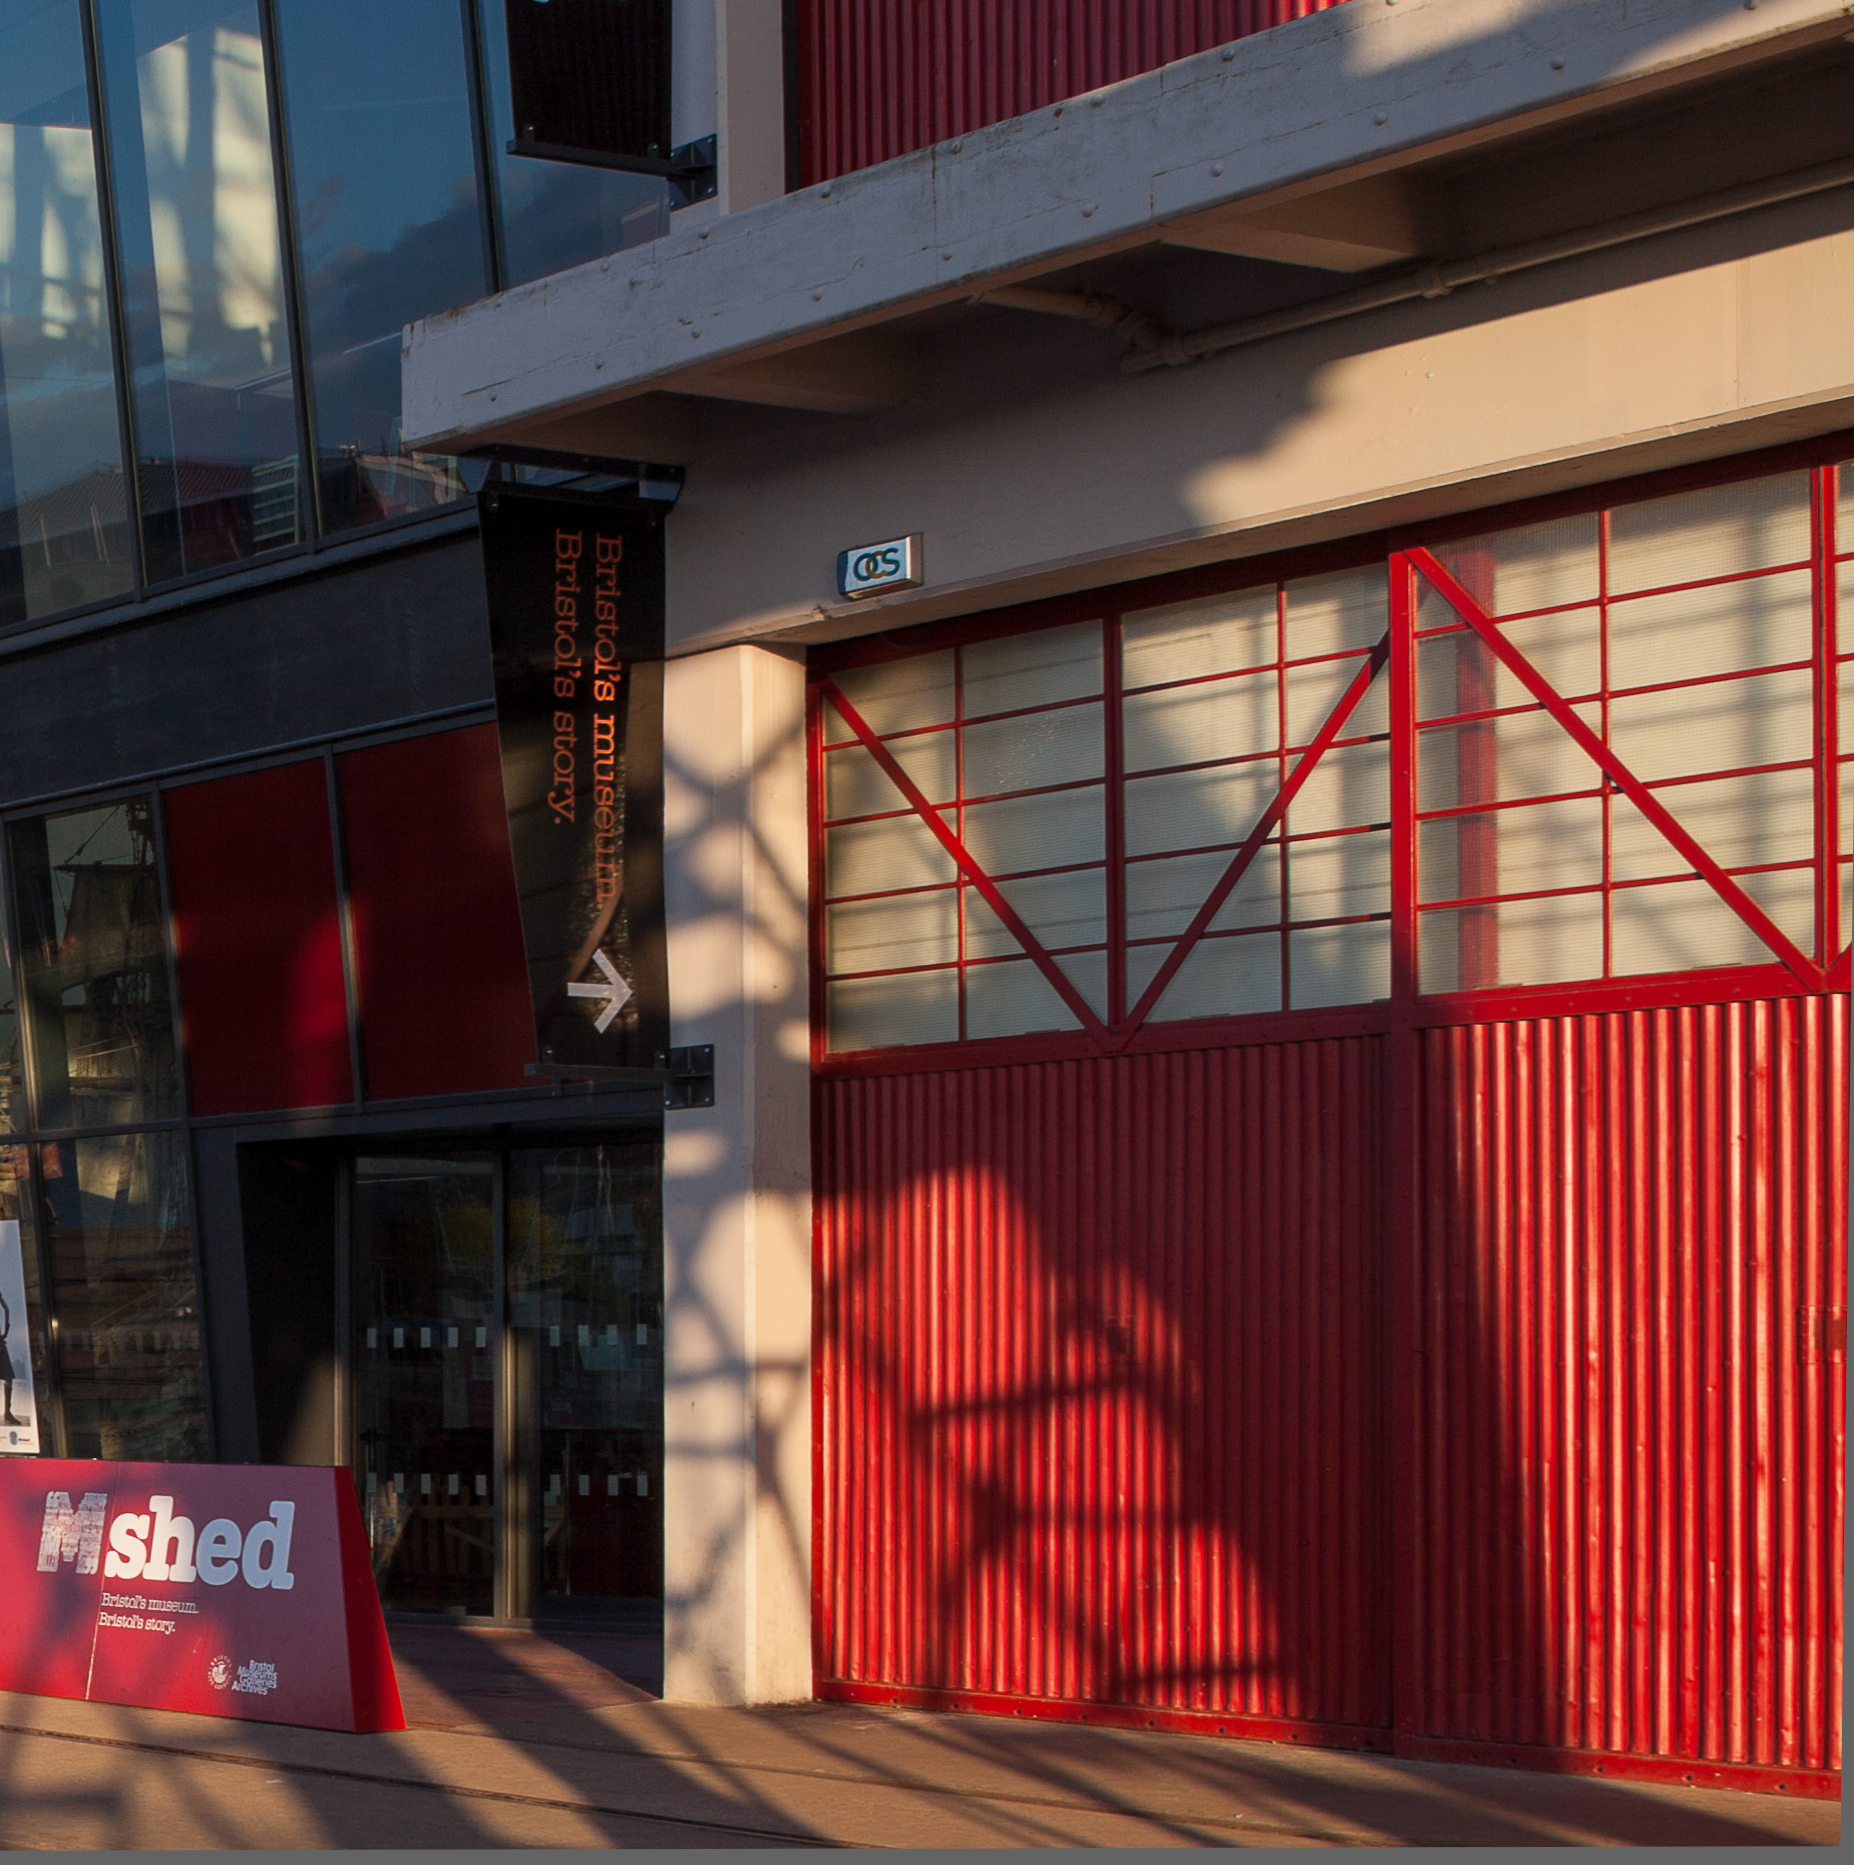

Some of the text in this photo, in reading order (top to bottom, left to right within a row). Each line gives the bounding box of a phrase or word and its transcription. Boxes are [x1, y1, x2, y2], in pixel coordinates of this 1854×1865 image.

[852, 546, 900, 582] OCS
[595, 533, 623, 702] Bristol's
[547, 528, 583, 825] Bristol's story.
[100, 1592, 199, 1614] Bristol's museum.
[98, 1611, 176, 1634] Bristol's story.
[237, 1665, 278, 1680] Museums
[249, 1659, 275, 1672] Bristol
[231, 1680, 268, 1695] Archives
[239, 1674, 277, 1689] Galleries
